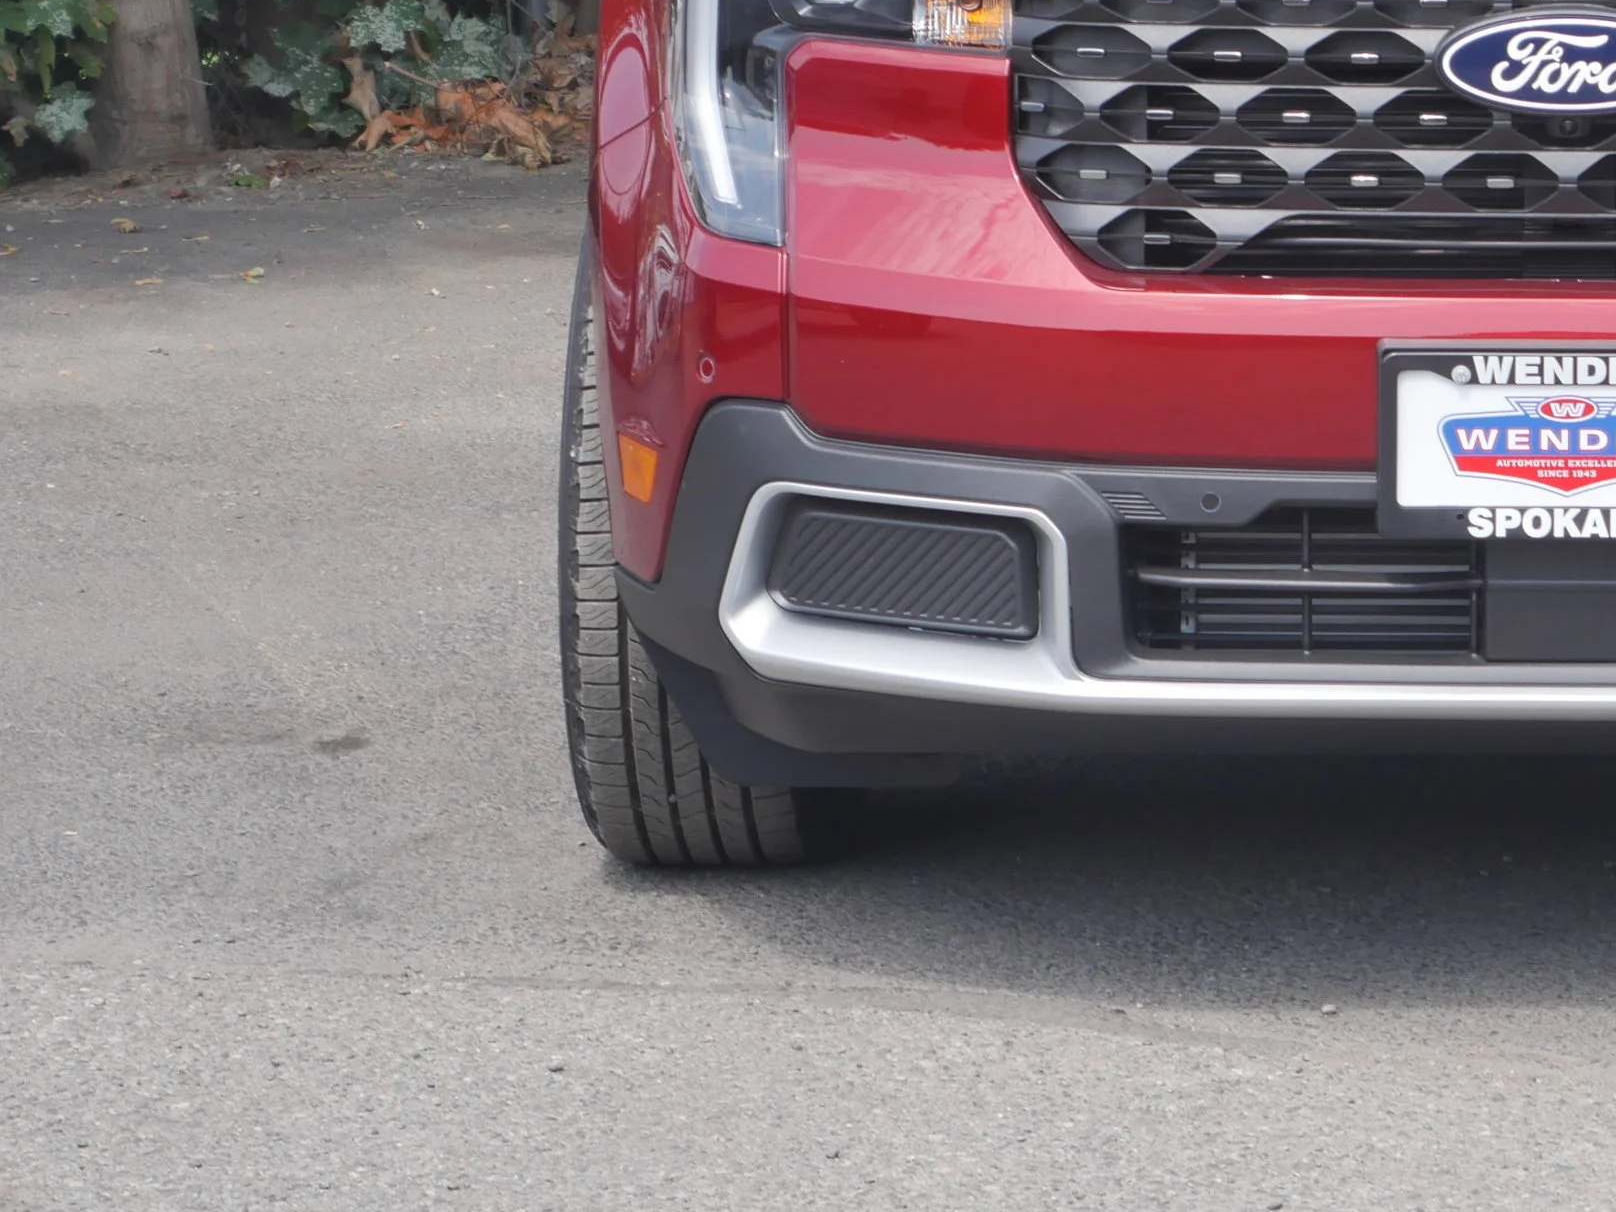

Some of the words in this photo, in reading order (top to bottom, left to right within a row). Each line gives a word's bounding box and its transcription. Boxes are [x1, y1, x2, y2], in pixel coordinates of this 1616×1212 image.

[1549, 402, 1586, 418] W
[1496, 459, 1565, 468] AUTOMOTIVE
[1537, 469, 1569, 478] SINCE
[1572, 469, 1598, 478] 1943
